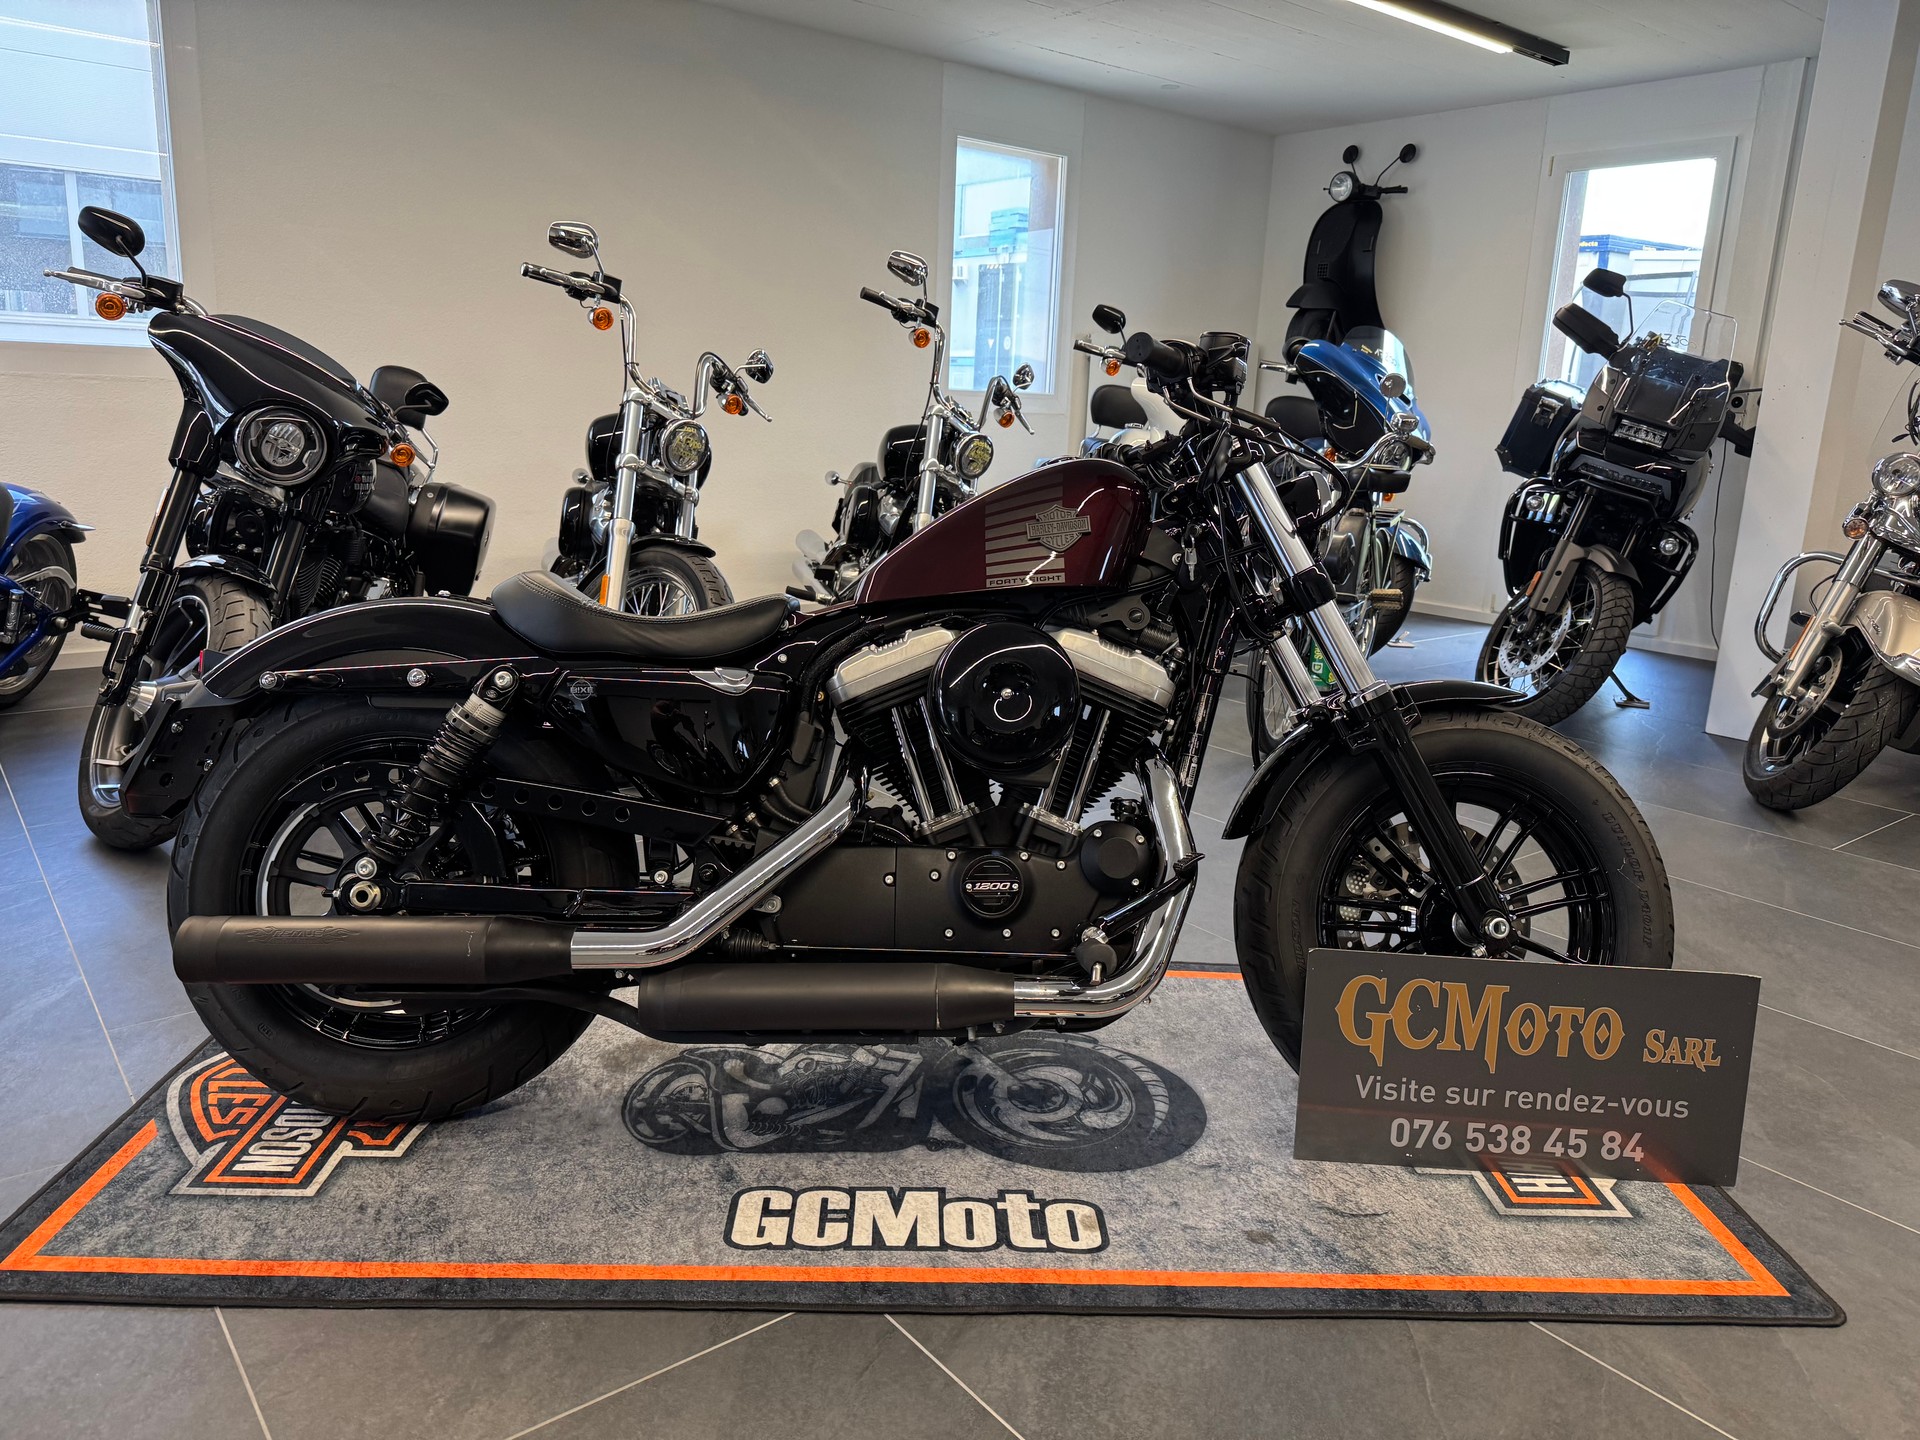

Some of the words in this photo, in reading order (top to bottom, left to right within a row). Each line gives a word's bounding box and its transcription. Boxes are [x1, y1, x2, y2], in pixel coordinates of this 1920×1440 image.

[1043, 510, 1073, 521] MOTOR
[1030, 519, 1087, 536] HARLEY-DAVIDSON
[1045, 533, 1075, 547] CYCLES
[973, 881, 1011, 890] 1200
[1355, 1073, 1436, 1103] Visite
[1445, 1083, 1496, 1107] sur
[1504, 1088, 1689, 1120] rendez-vous
[1390, 1117, 1452, 1151] 076
[1465, 1121, 1531, 1156] 538
[1543, 1126, 1588, 1159] 45
[1601, 1130, 1645, 1163] 84
[730, 1187, 1103, 1250] GCMoto
